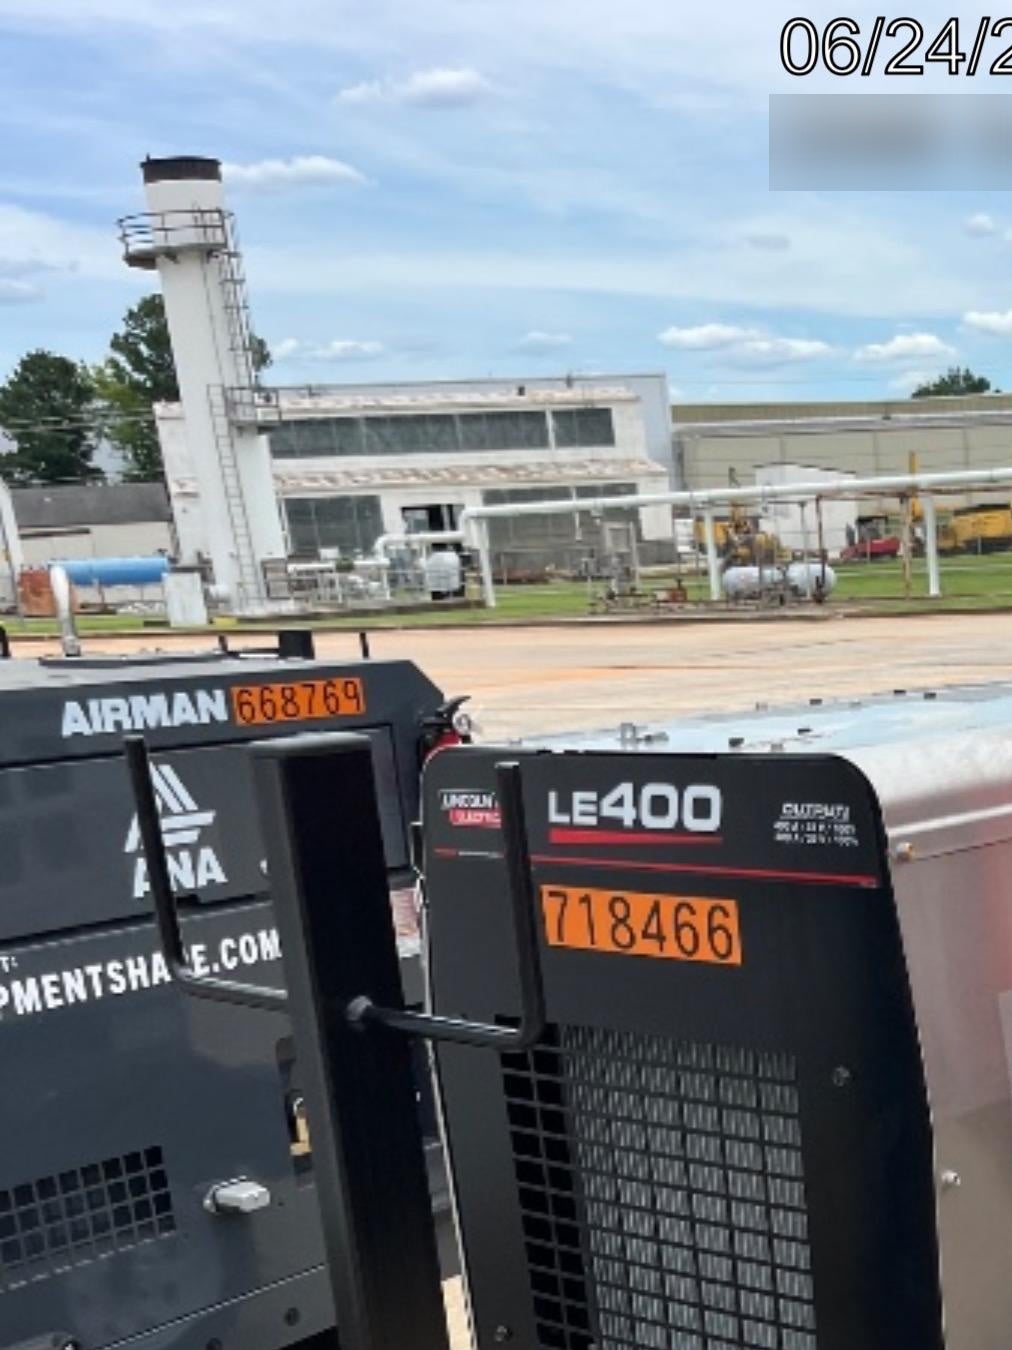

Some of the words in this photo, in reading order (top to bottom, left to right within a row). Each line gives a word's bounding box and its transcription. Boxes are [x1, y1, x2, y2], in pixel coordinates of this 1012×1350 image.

[61, 689, 229, 737] AIRMAN
[234, 680, 362, 724] 668769
[547, 781, 722, 833] LE400
[547, 890, 734, 961] 718466
